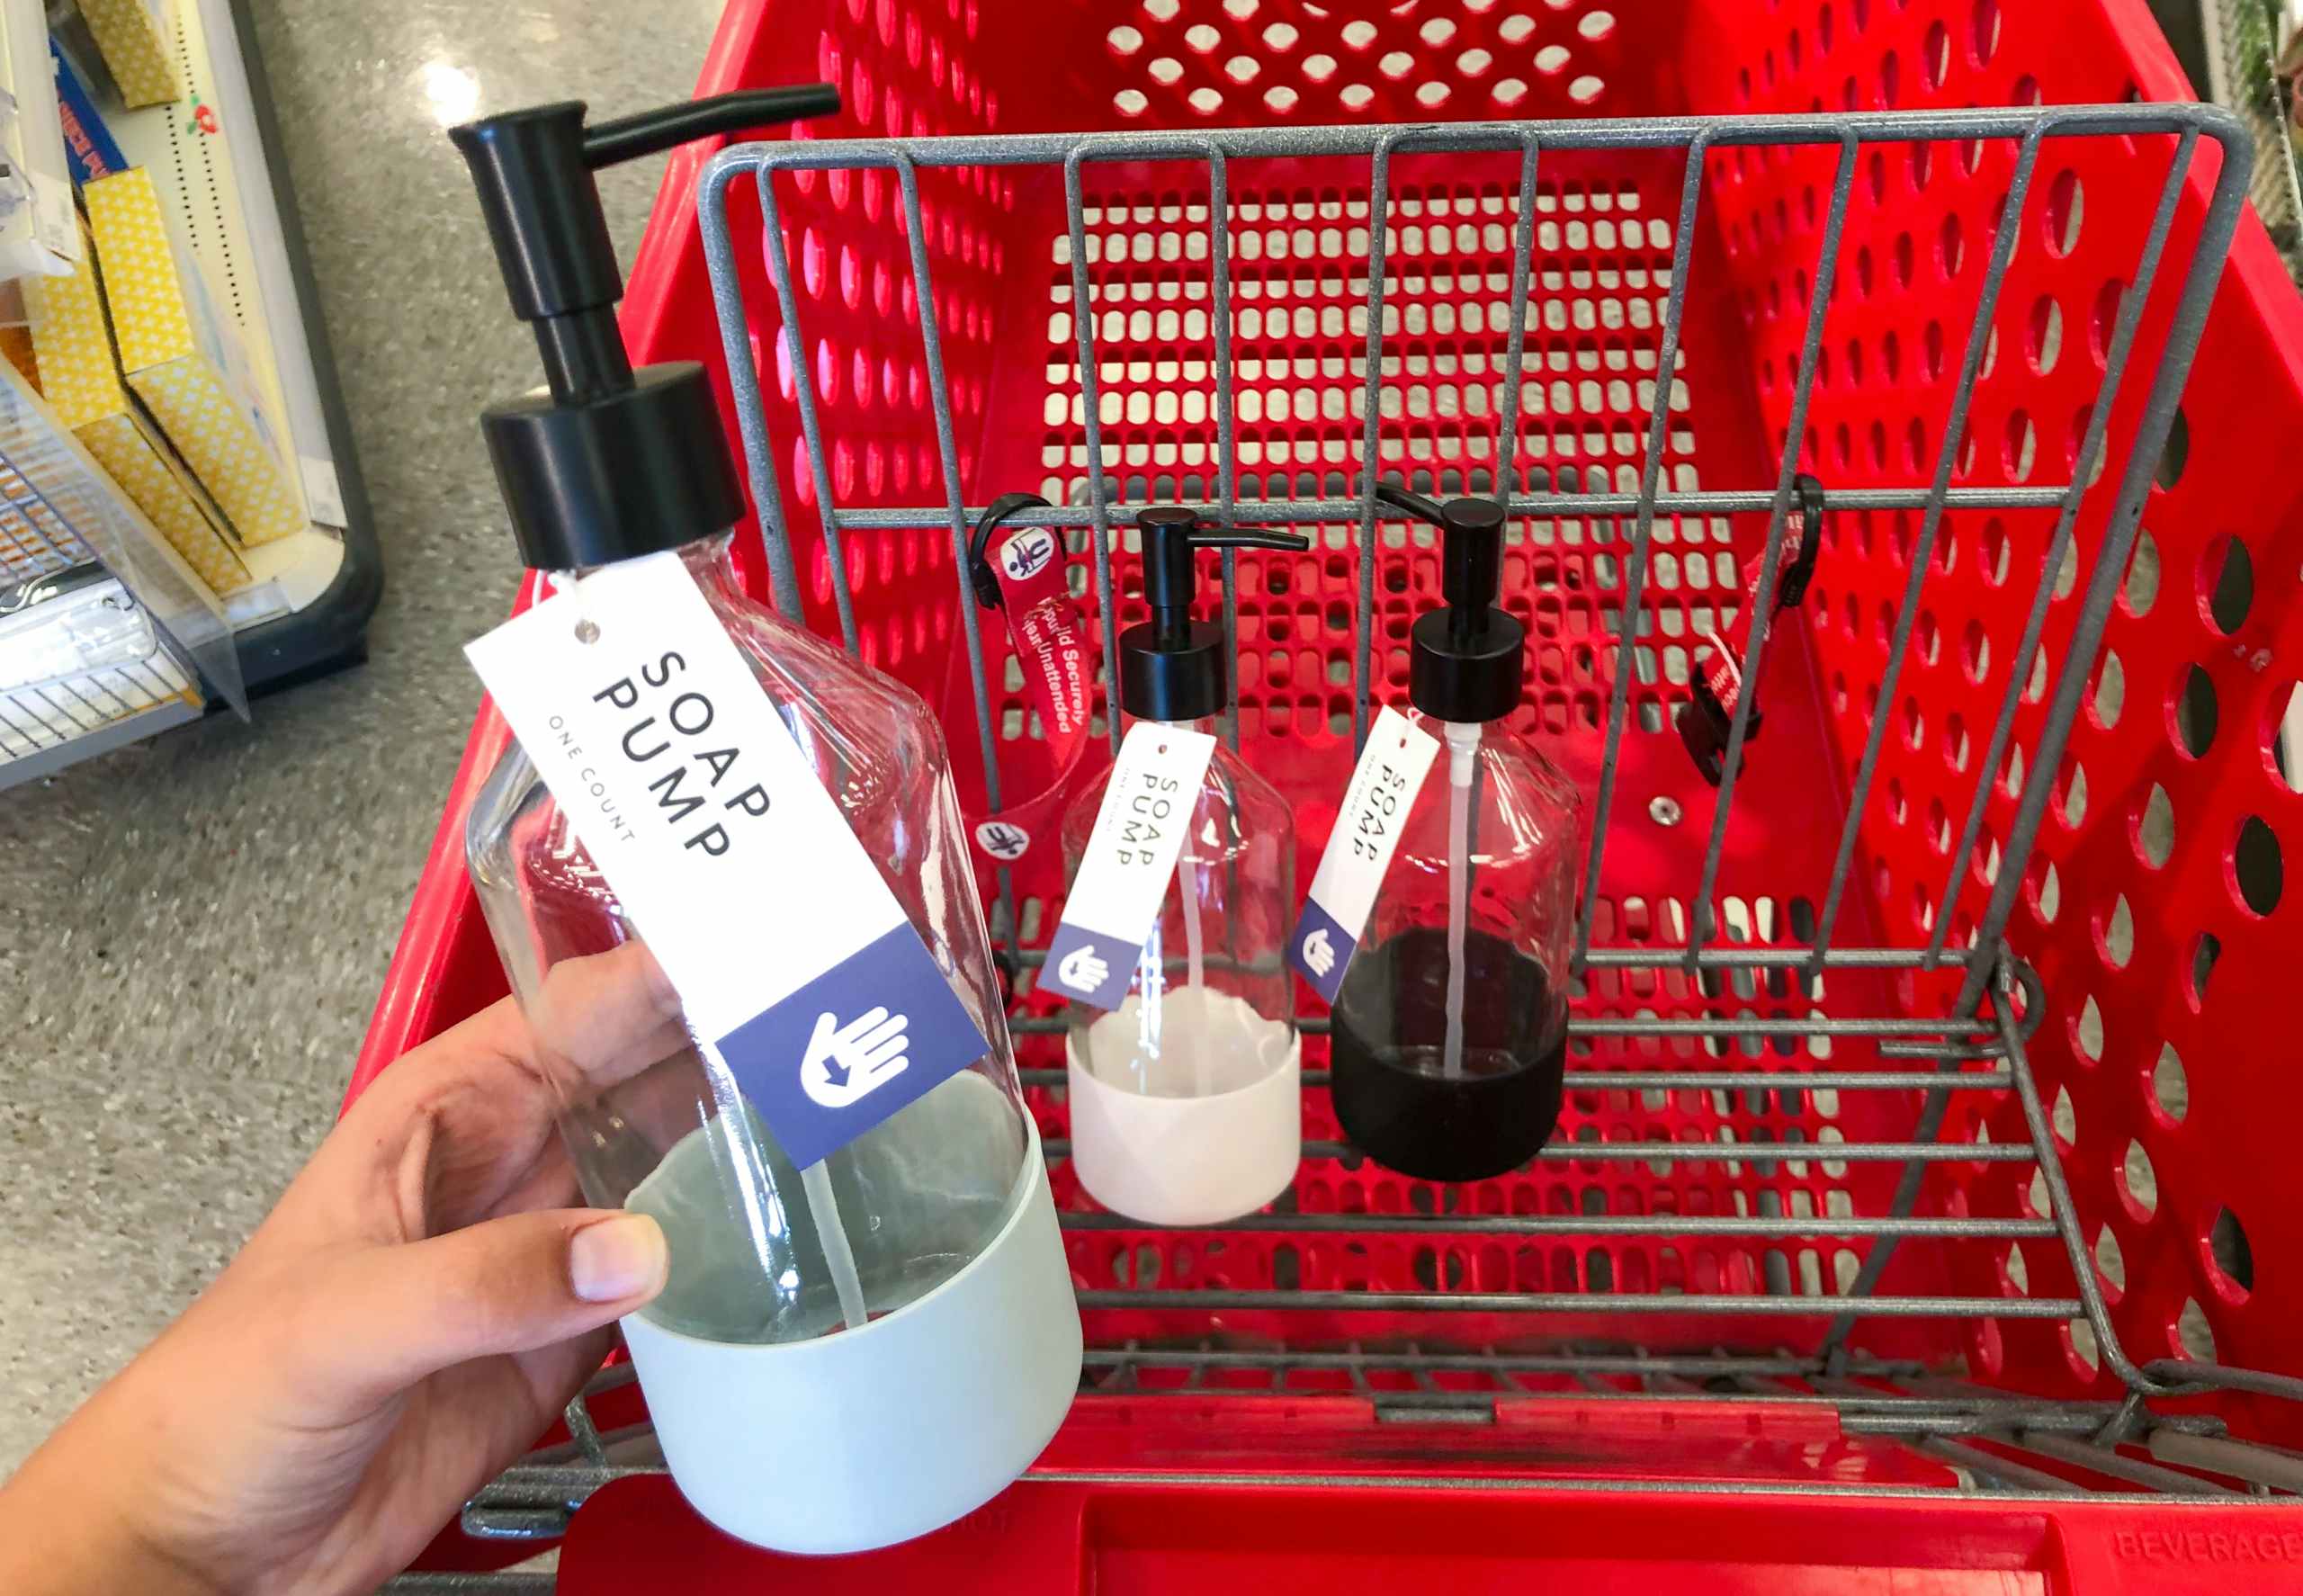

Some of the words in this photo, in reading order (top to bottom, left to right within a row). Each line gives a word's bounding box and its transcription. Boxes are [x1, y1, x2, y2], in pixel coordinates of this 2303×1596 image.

[1037, 641, 1071, 733] Unattended
[1062, 649, 1085, 726] Securely
[549, 715, 582, 759] ONE
[581, 767, 635, 842] COUNT
[592, 677, 730, 856] PUMP
[641, 651, 770, 817] SOAP
[1116, 773, 1159, 865] PUMP
[1138, 777, 1178, 865] SOAP
[1353, 765, 1393, 856] PUMP
[1367, 774, 1405, 861] SOAP
